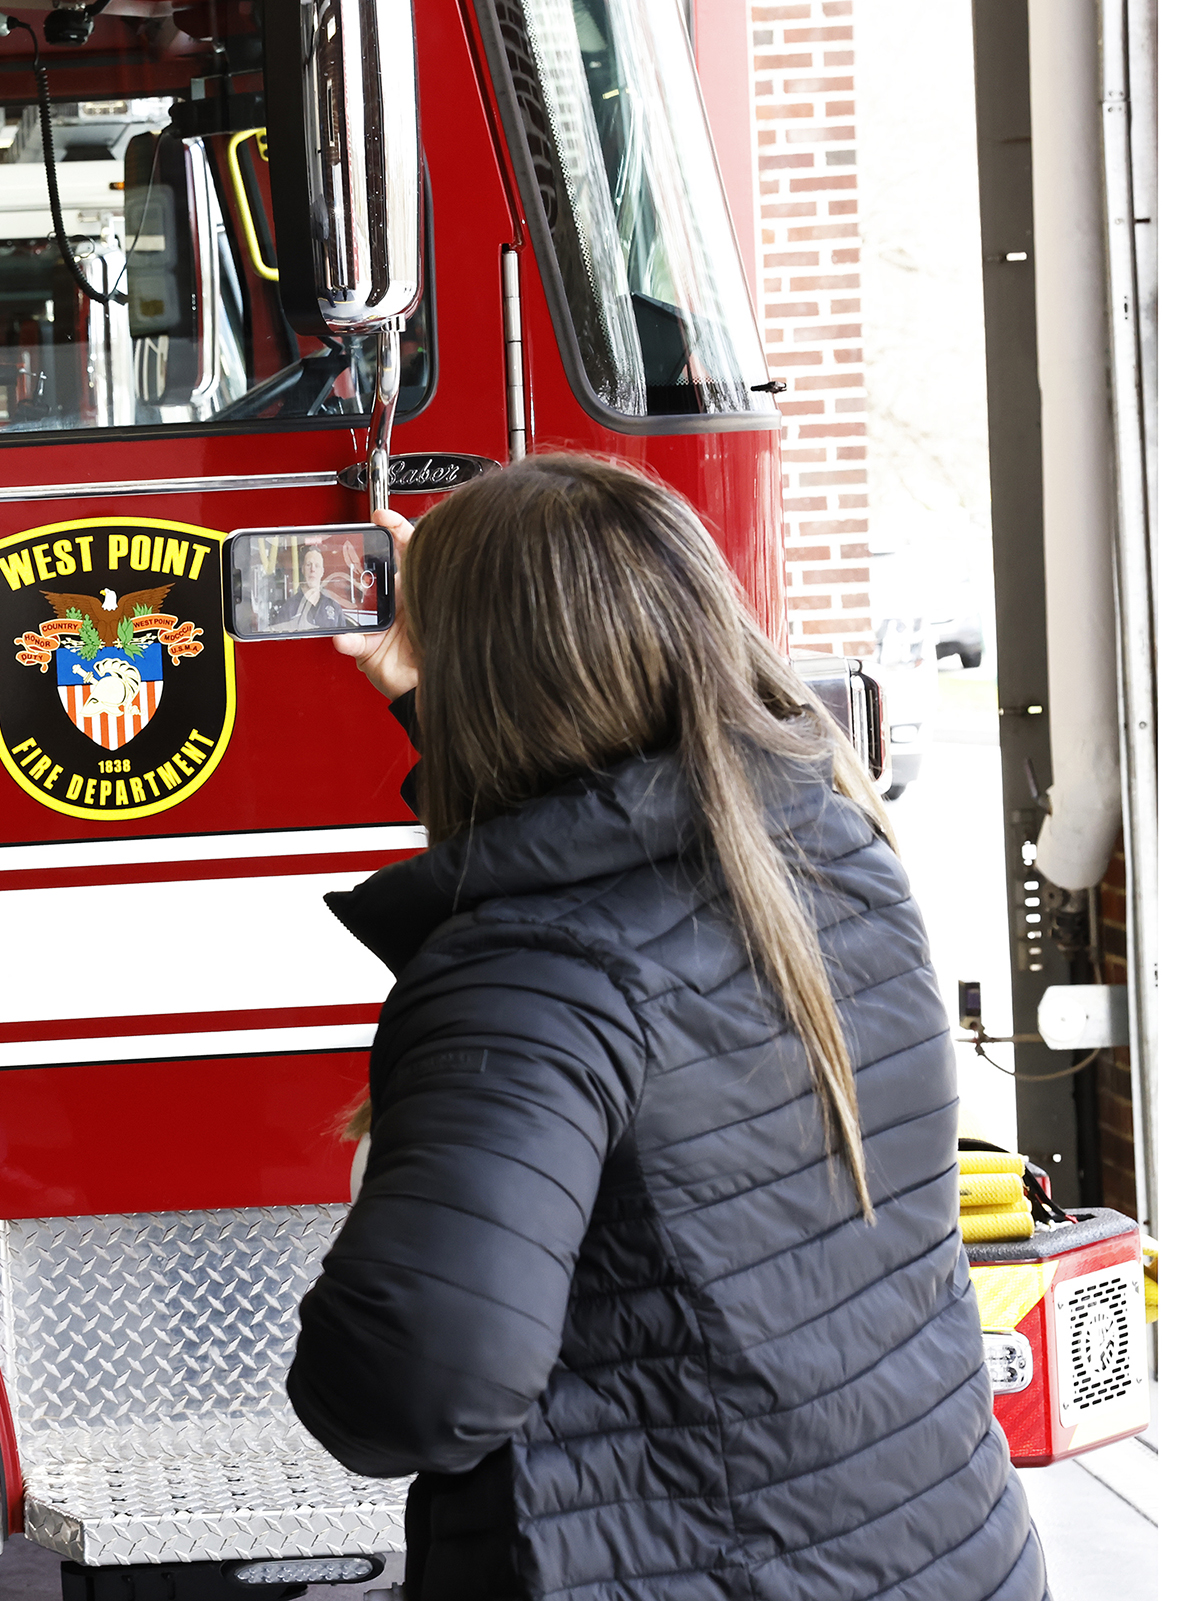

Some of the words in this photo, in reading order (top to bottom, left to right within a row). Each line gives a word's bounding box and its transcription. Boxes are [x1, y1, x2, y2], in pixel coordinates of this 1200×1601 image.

[388, 458, 460, 485] Saber
[108, 533, 211, 581] POINT
[41, 622, 79, 633] COUNTRY
[133, 619, 153, 629] WEST
[153, 617, 175, 627] POINT
[24, 633, 51, 648] HONOR
[164, 625, 192, 641] MDCCCII
[21, 653, 43, 662] DUTY
[11, 736, 64, 790] FIRE
[65, 728, 215, 806] DEPARTMENT
[98, 759, 131, 773] 1838
